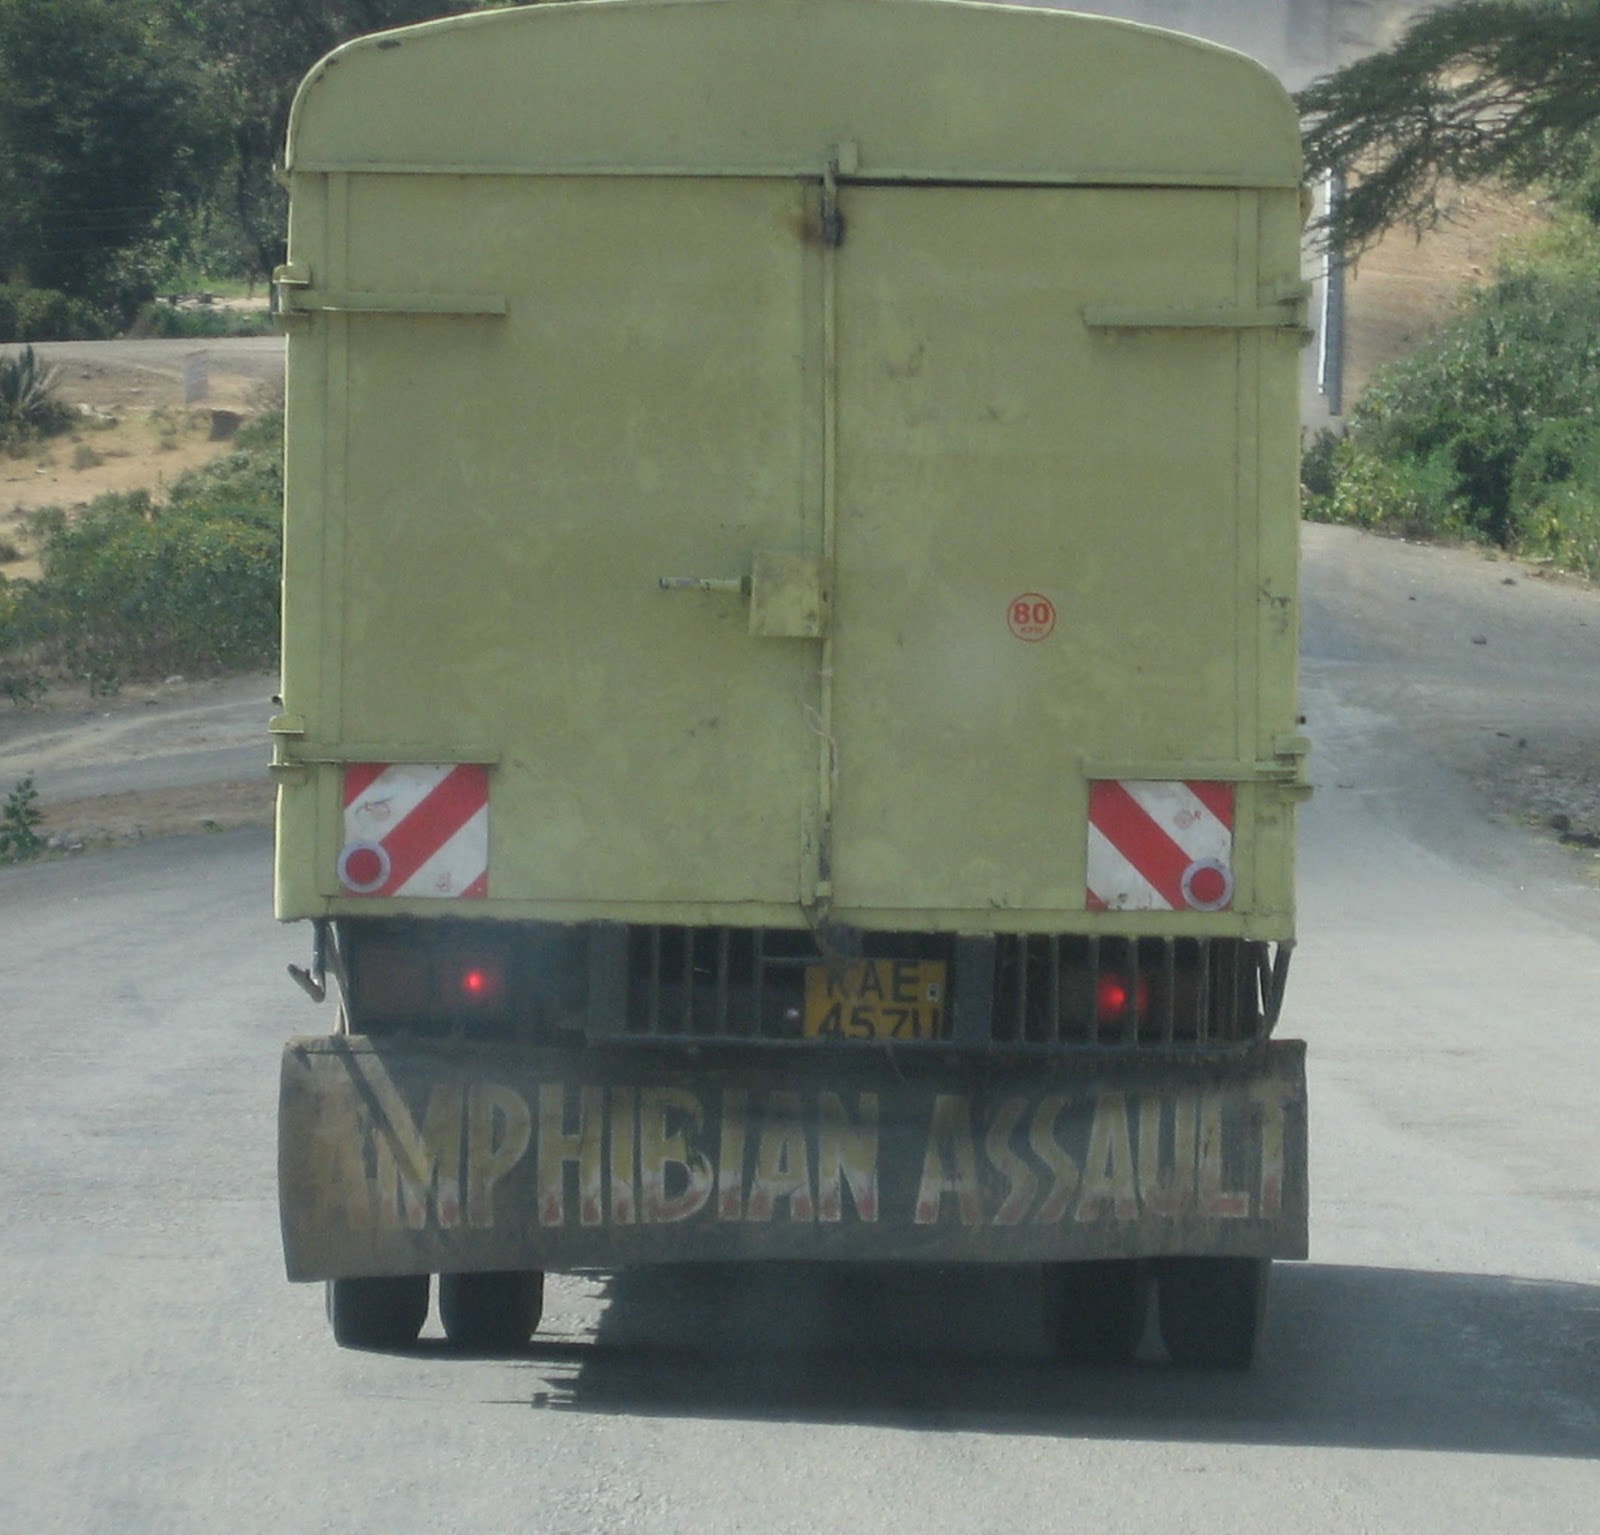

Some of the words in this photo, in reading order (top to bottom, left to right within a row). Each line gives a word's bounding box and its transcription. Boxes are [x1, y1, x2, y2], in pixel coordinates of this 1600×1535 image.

[1014, 602, 1050, 625] 80
[314, 1080, 880, 1230] AMPHIBIAN
[914, 1081, 1292, 1226] ASSAULT
